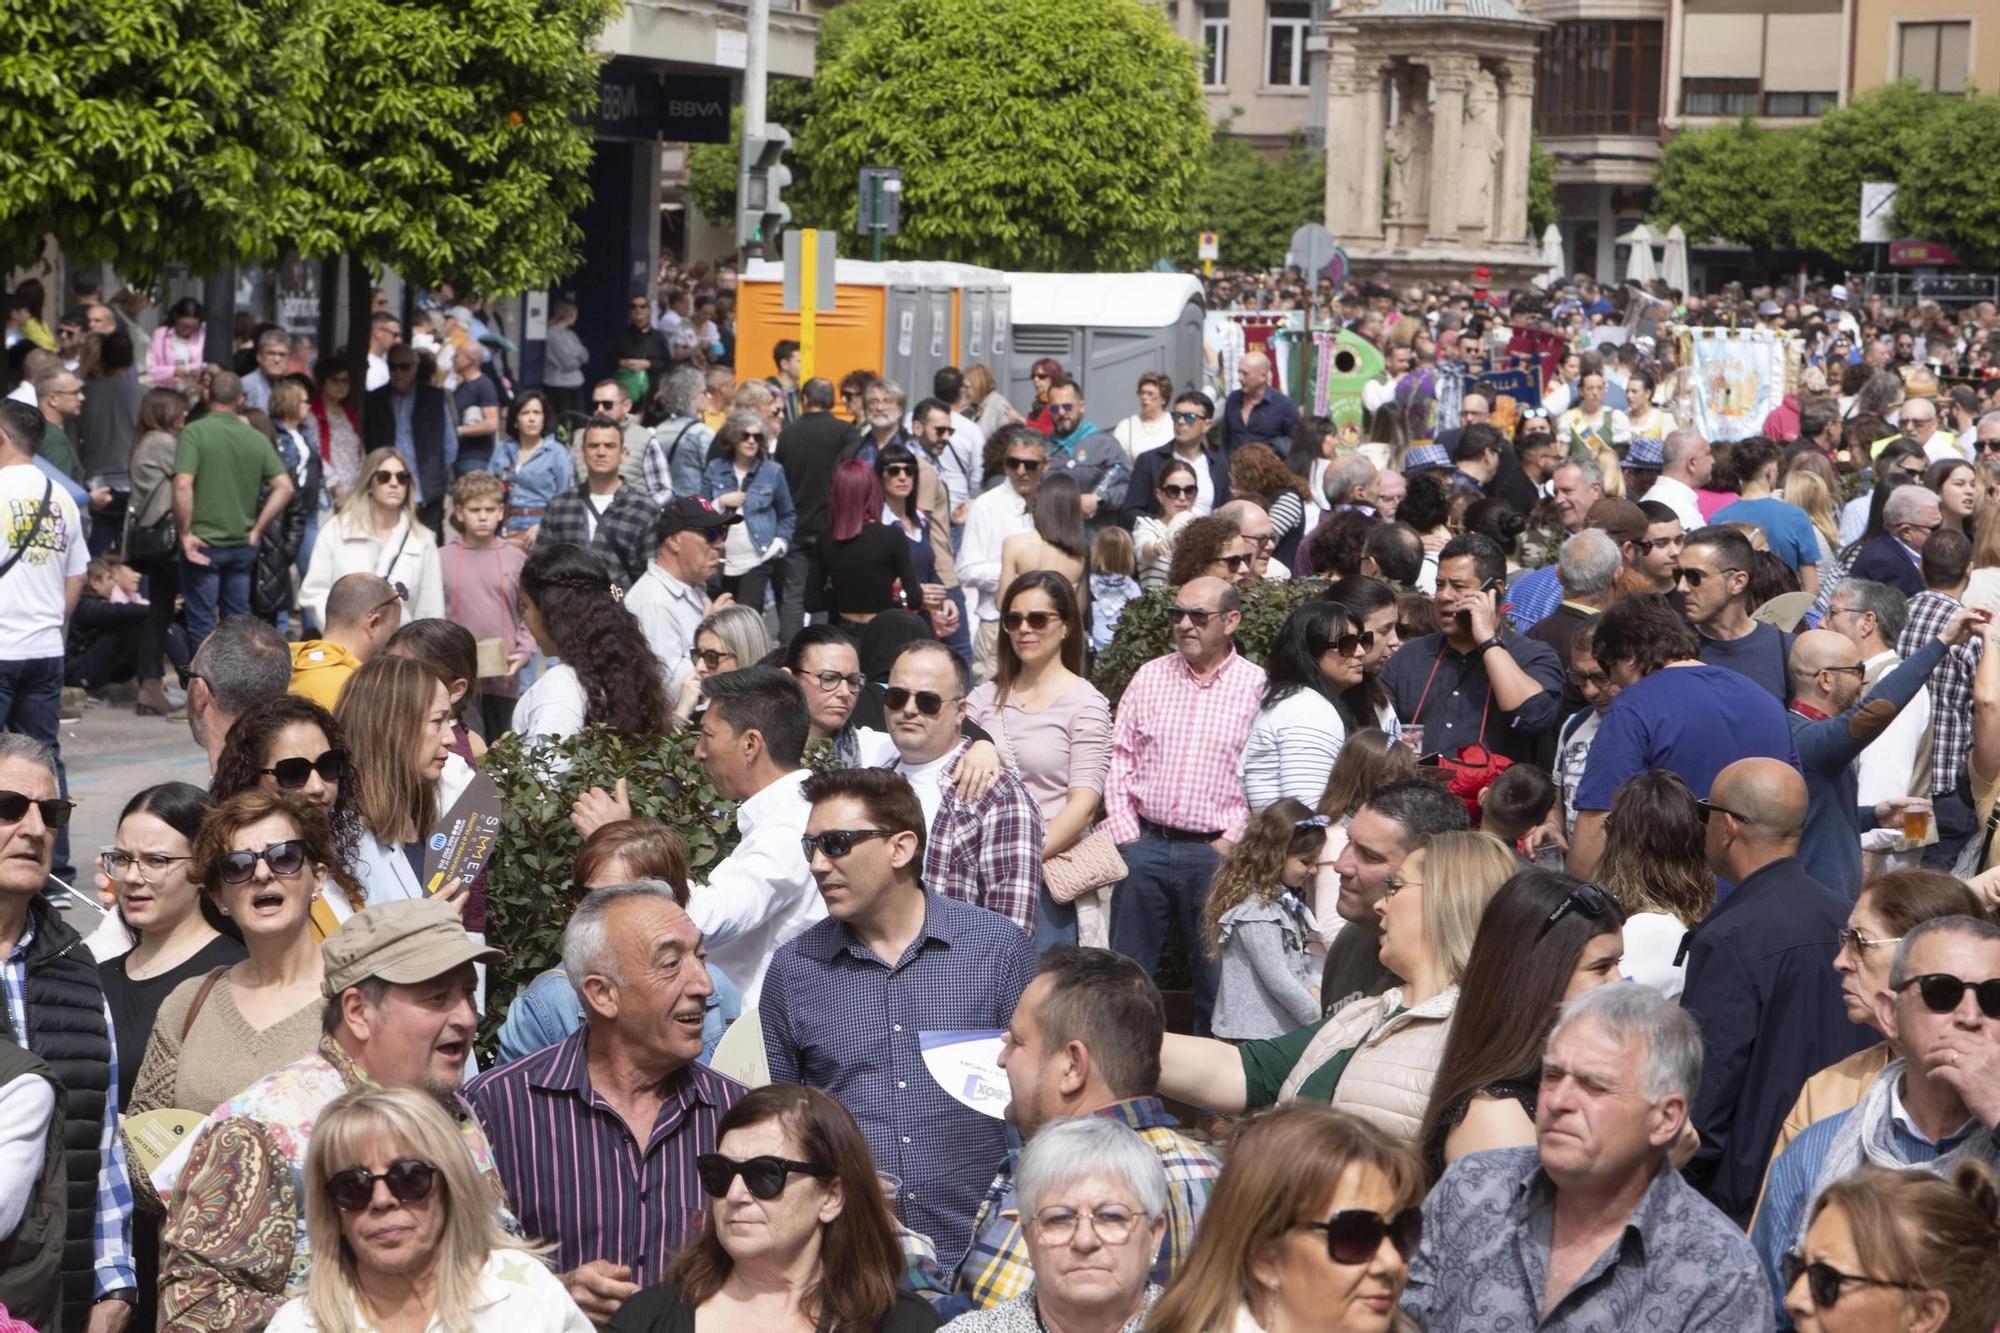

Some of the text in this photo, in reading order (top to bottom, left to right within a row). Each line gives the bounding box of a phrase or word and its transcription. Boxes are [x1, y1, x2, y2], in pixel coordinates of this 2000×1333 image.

[602, 84, 638, 120] BBVA
[669, 100, 723, 117] BBVA
[462, 816, 499, 884] SIMMER
[977, 1082, 1009, 1100] BOX
